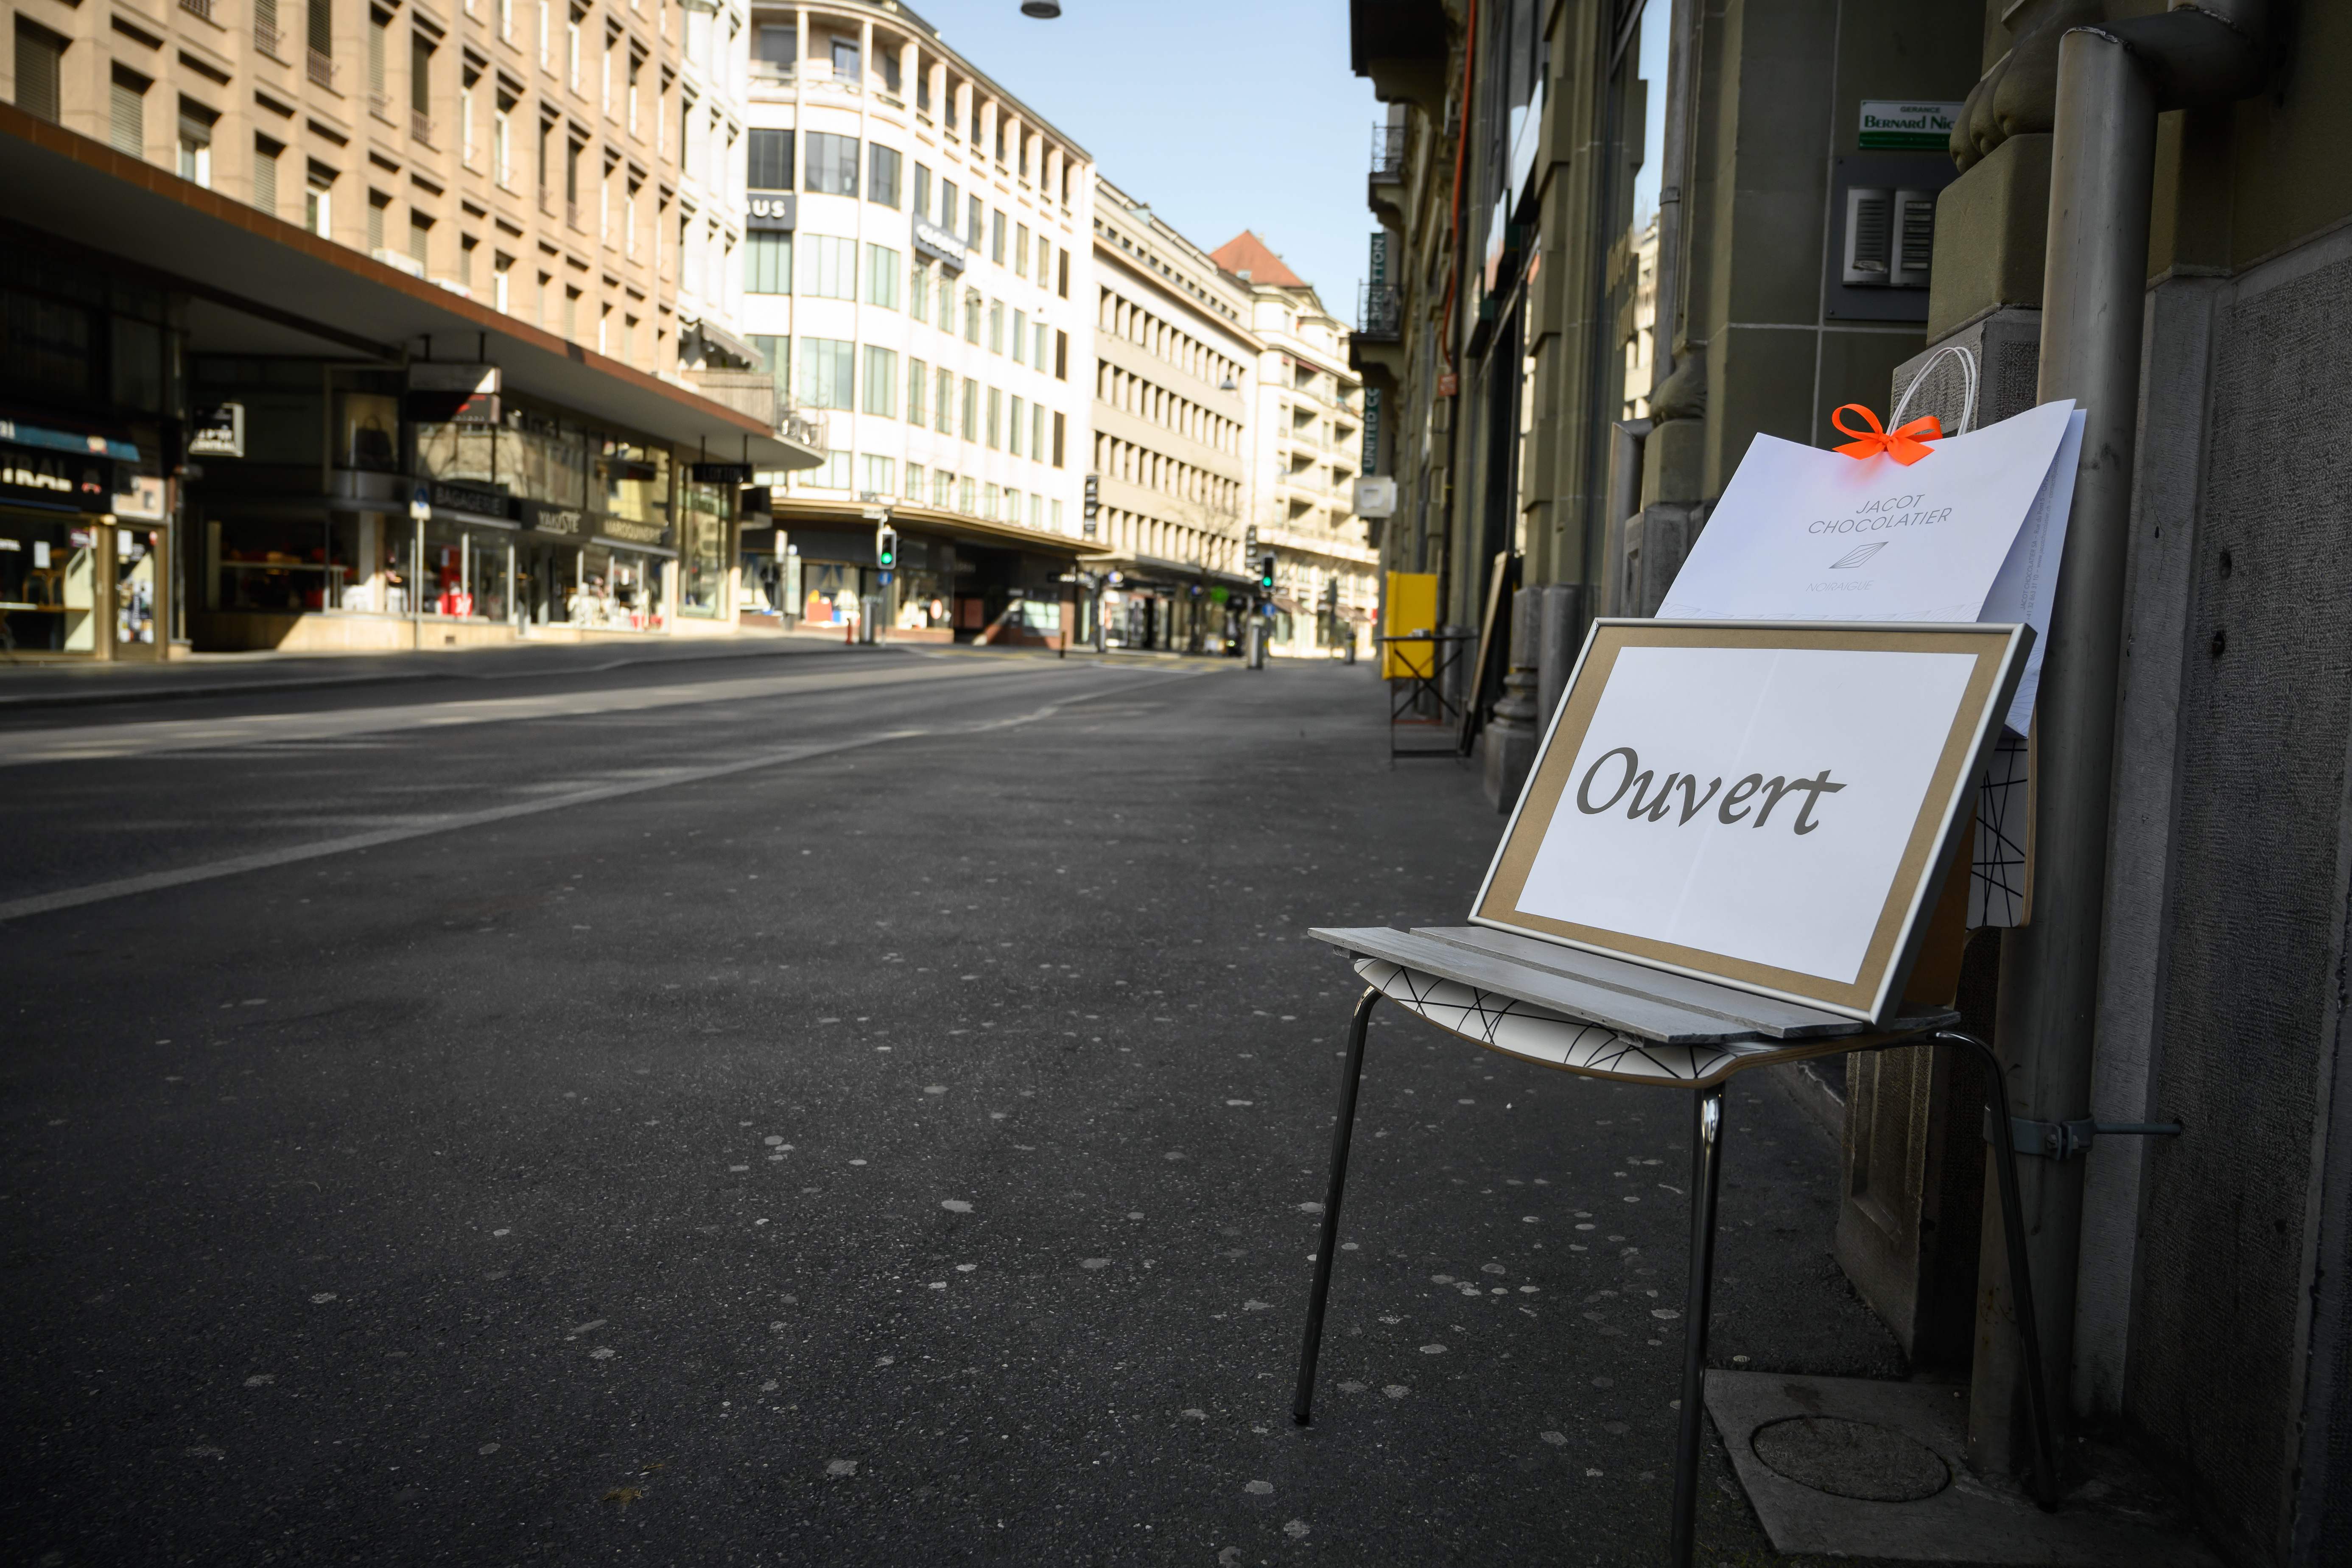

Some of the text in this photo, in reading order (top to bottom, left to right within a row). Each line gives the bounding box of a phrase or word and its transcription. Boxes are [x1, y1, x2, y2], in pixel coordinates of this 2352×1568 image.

[1363, 412, 1378, 468] UNITED
[1856, 494, 1925, 514] JACOT
[1808, 508, 1952, 534] CHOCOLATIER
[2031, 540, 2038, 548] SA
[2024, 549, 2036, 589] CHOCOLATIER
[1805, 580, 1874, 592] NOIRAIGUE
[2020, 590, 2029, 610] JACOT
[1576, 747, 1848, 836] Ouvert
